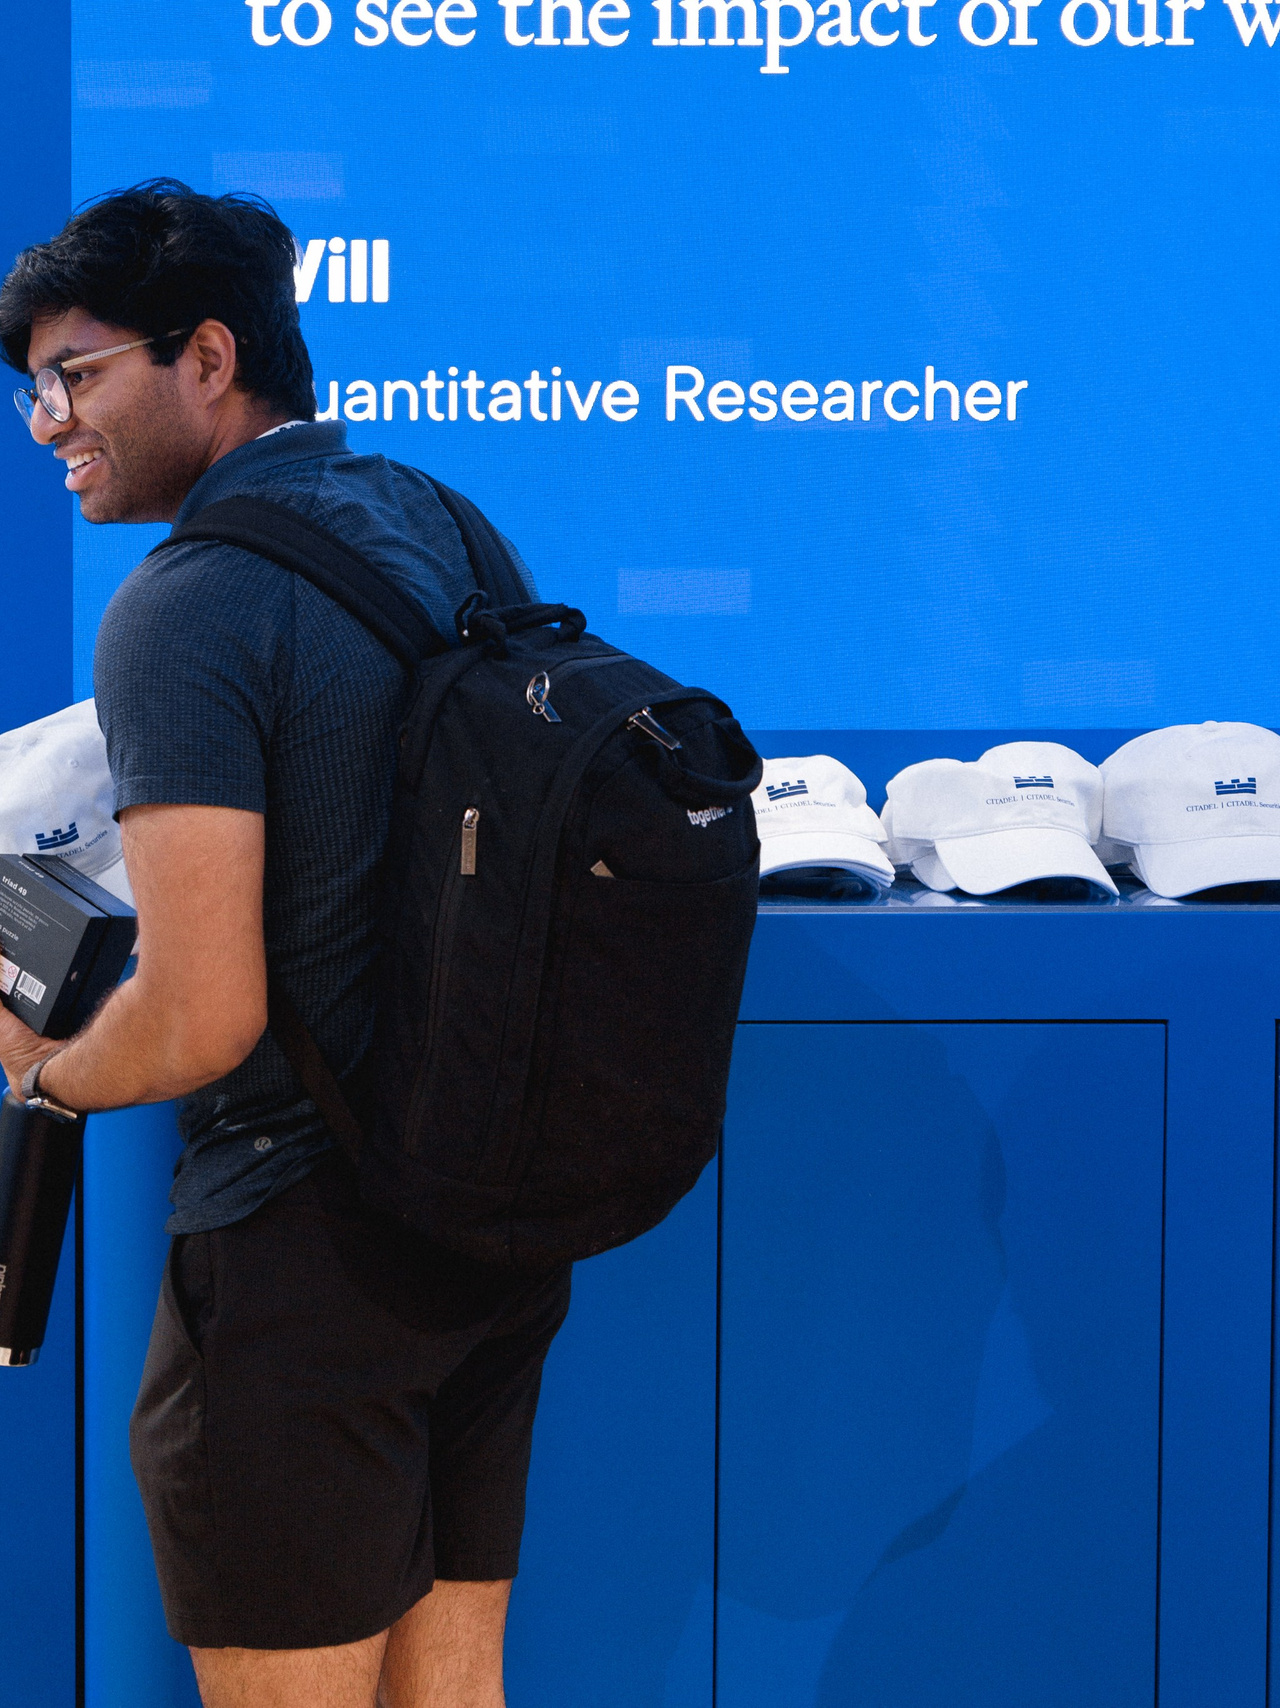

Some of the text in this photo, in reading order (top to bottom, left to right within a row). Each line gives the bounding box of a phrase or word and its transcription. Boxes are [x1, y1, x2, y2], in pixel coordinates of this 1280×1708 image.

[245, 0, 1280, 73] to see the impact of our w
[316, 366, 1028, 421] uantitative Researcher
[780, 800, 813, 810] CITADEL
[985, 796, 1018, 805] CITADEL
[1026, 794, 1056, 802] CITADEL
[1186, 803, 1219, 812] CITADEL
[1226, 800, 1259, 808] CITADEL
[84, 829, 108, 850] Securities
[2, 875, 19, 890] triad
[18, 886, 28, 896] 49
[2, 926, 19, 942] puzzle
